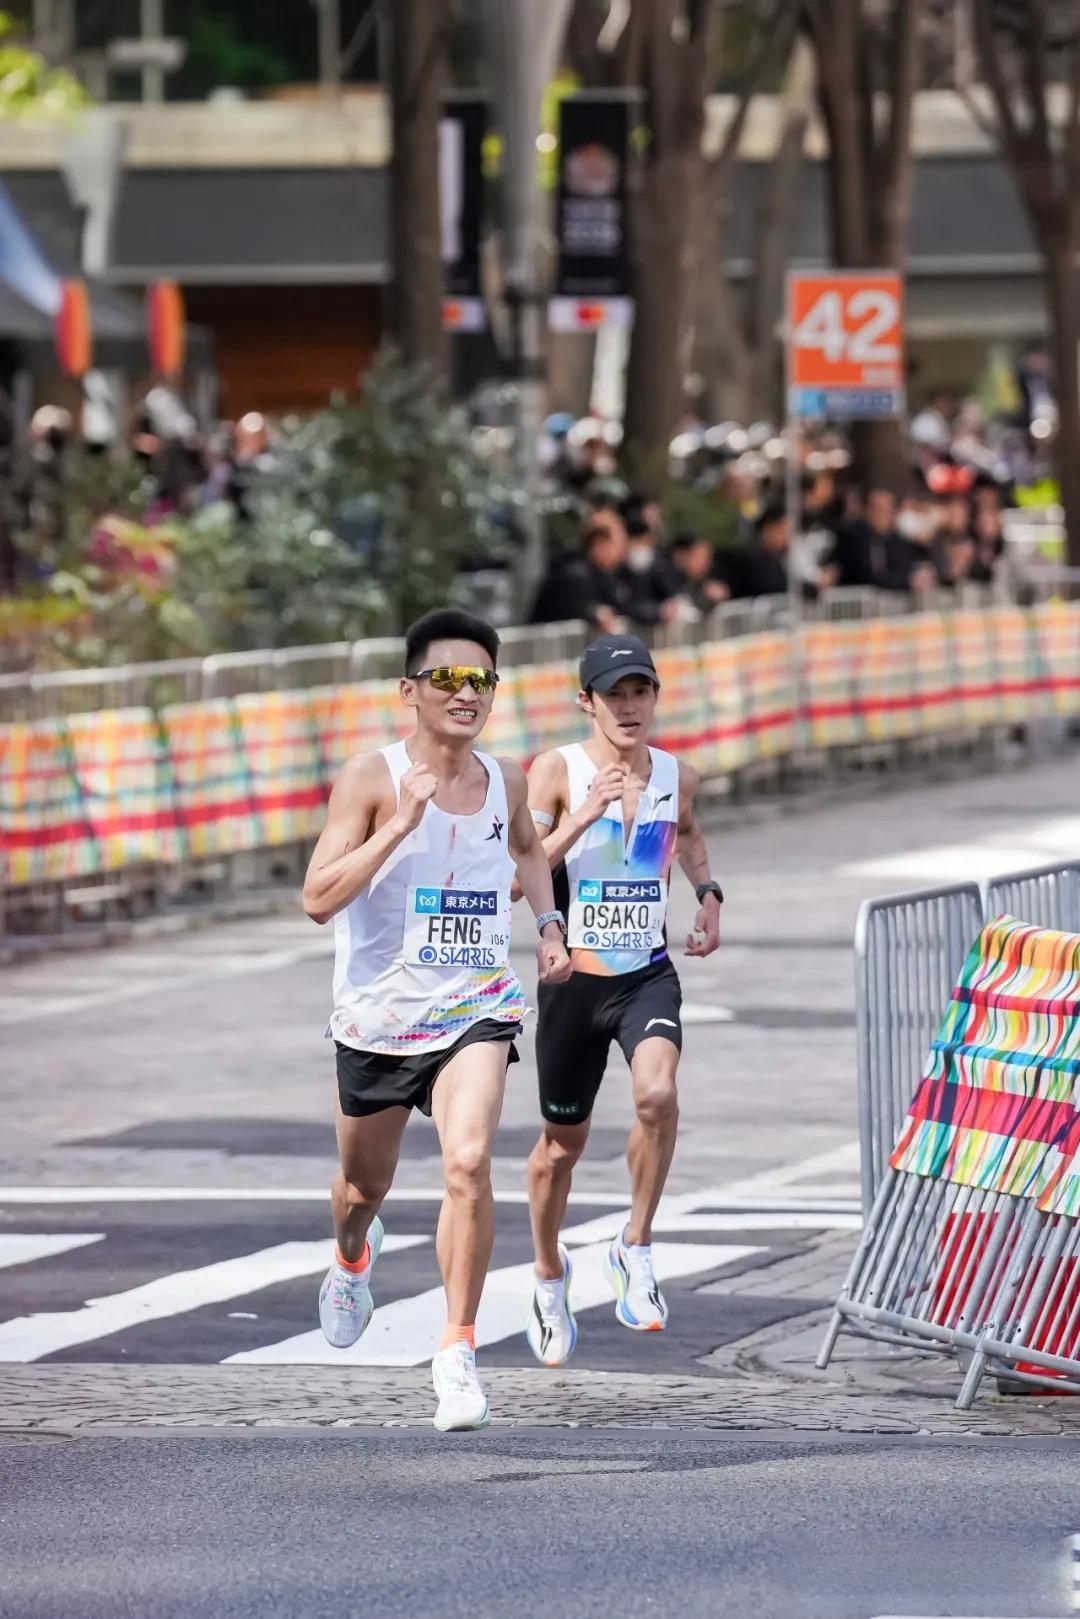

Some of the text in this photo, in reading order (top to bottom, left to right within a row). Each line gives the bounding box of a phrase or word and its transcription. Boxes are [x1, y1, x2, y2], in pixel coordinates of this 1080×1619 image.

[794, 288, 898, 363] 42
[604, 885, 659, 898] 東京メトロ
[445, 895, 495, 909] 東京メトロ
[583, 904, 649, 929] OSAKO
[428, 915, 482, 945] FENG
[491, 933, 505, 946] 106
[601, 931, 653, 948] STARTS
[439, 946, 496, 966] STARTS
